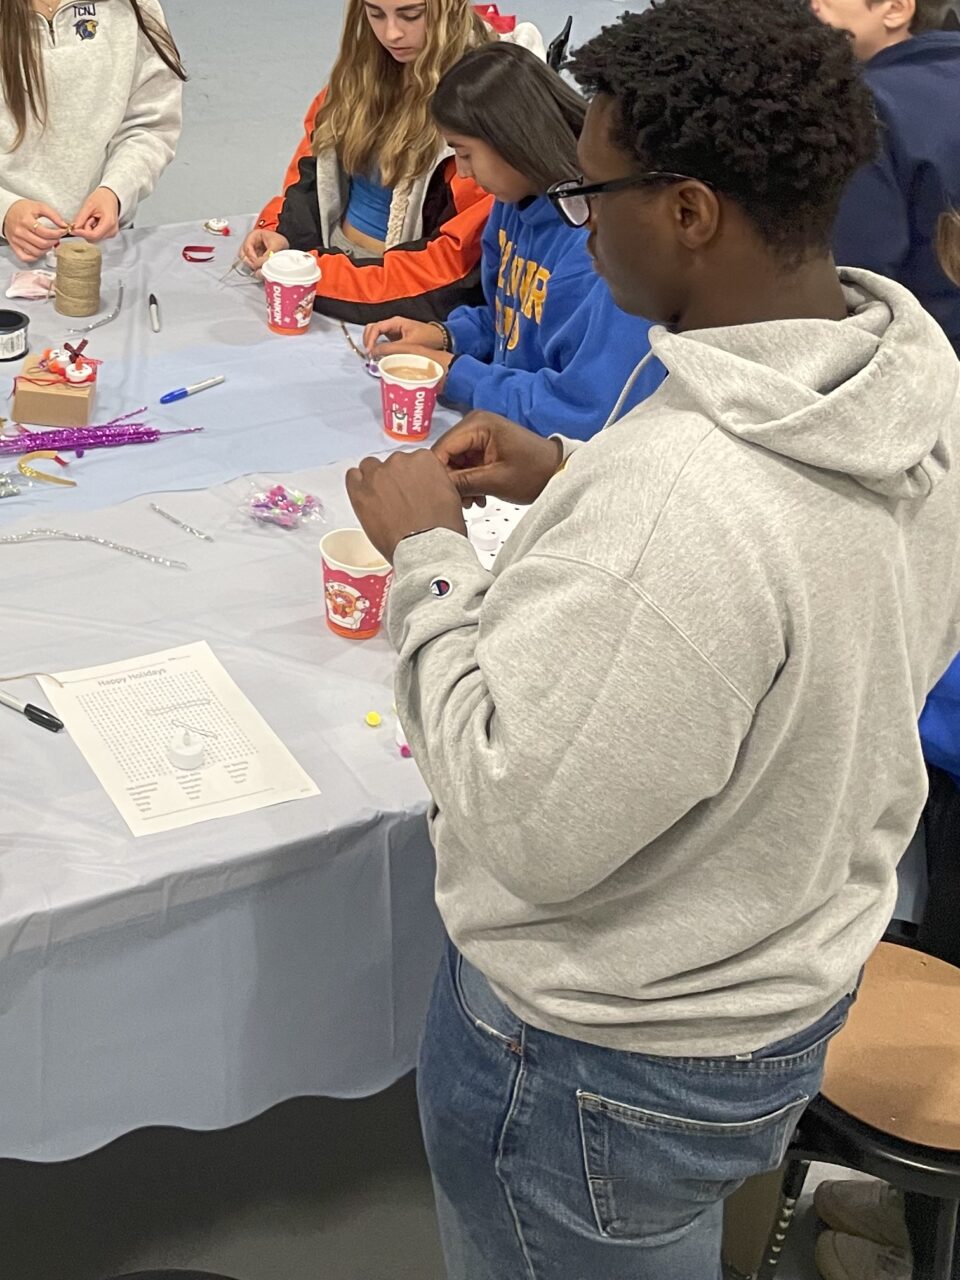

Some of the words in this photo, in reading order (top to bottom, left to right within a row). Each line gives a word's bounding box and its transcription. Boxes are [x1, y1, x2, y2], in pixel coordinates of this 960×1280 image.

[73, 3, 96, 18] TCNJ
[98, 677, 127, 687] Happy
[127, 668, 167, 681] Holidays
